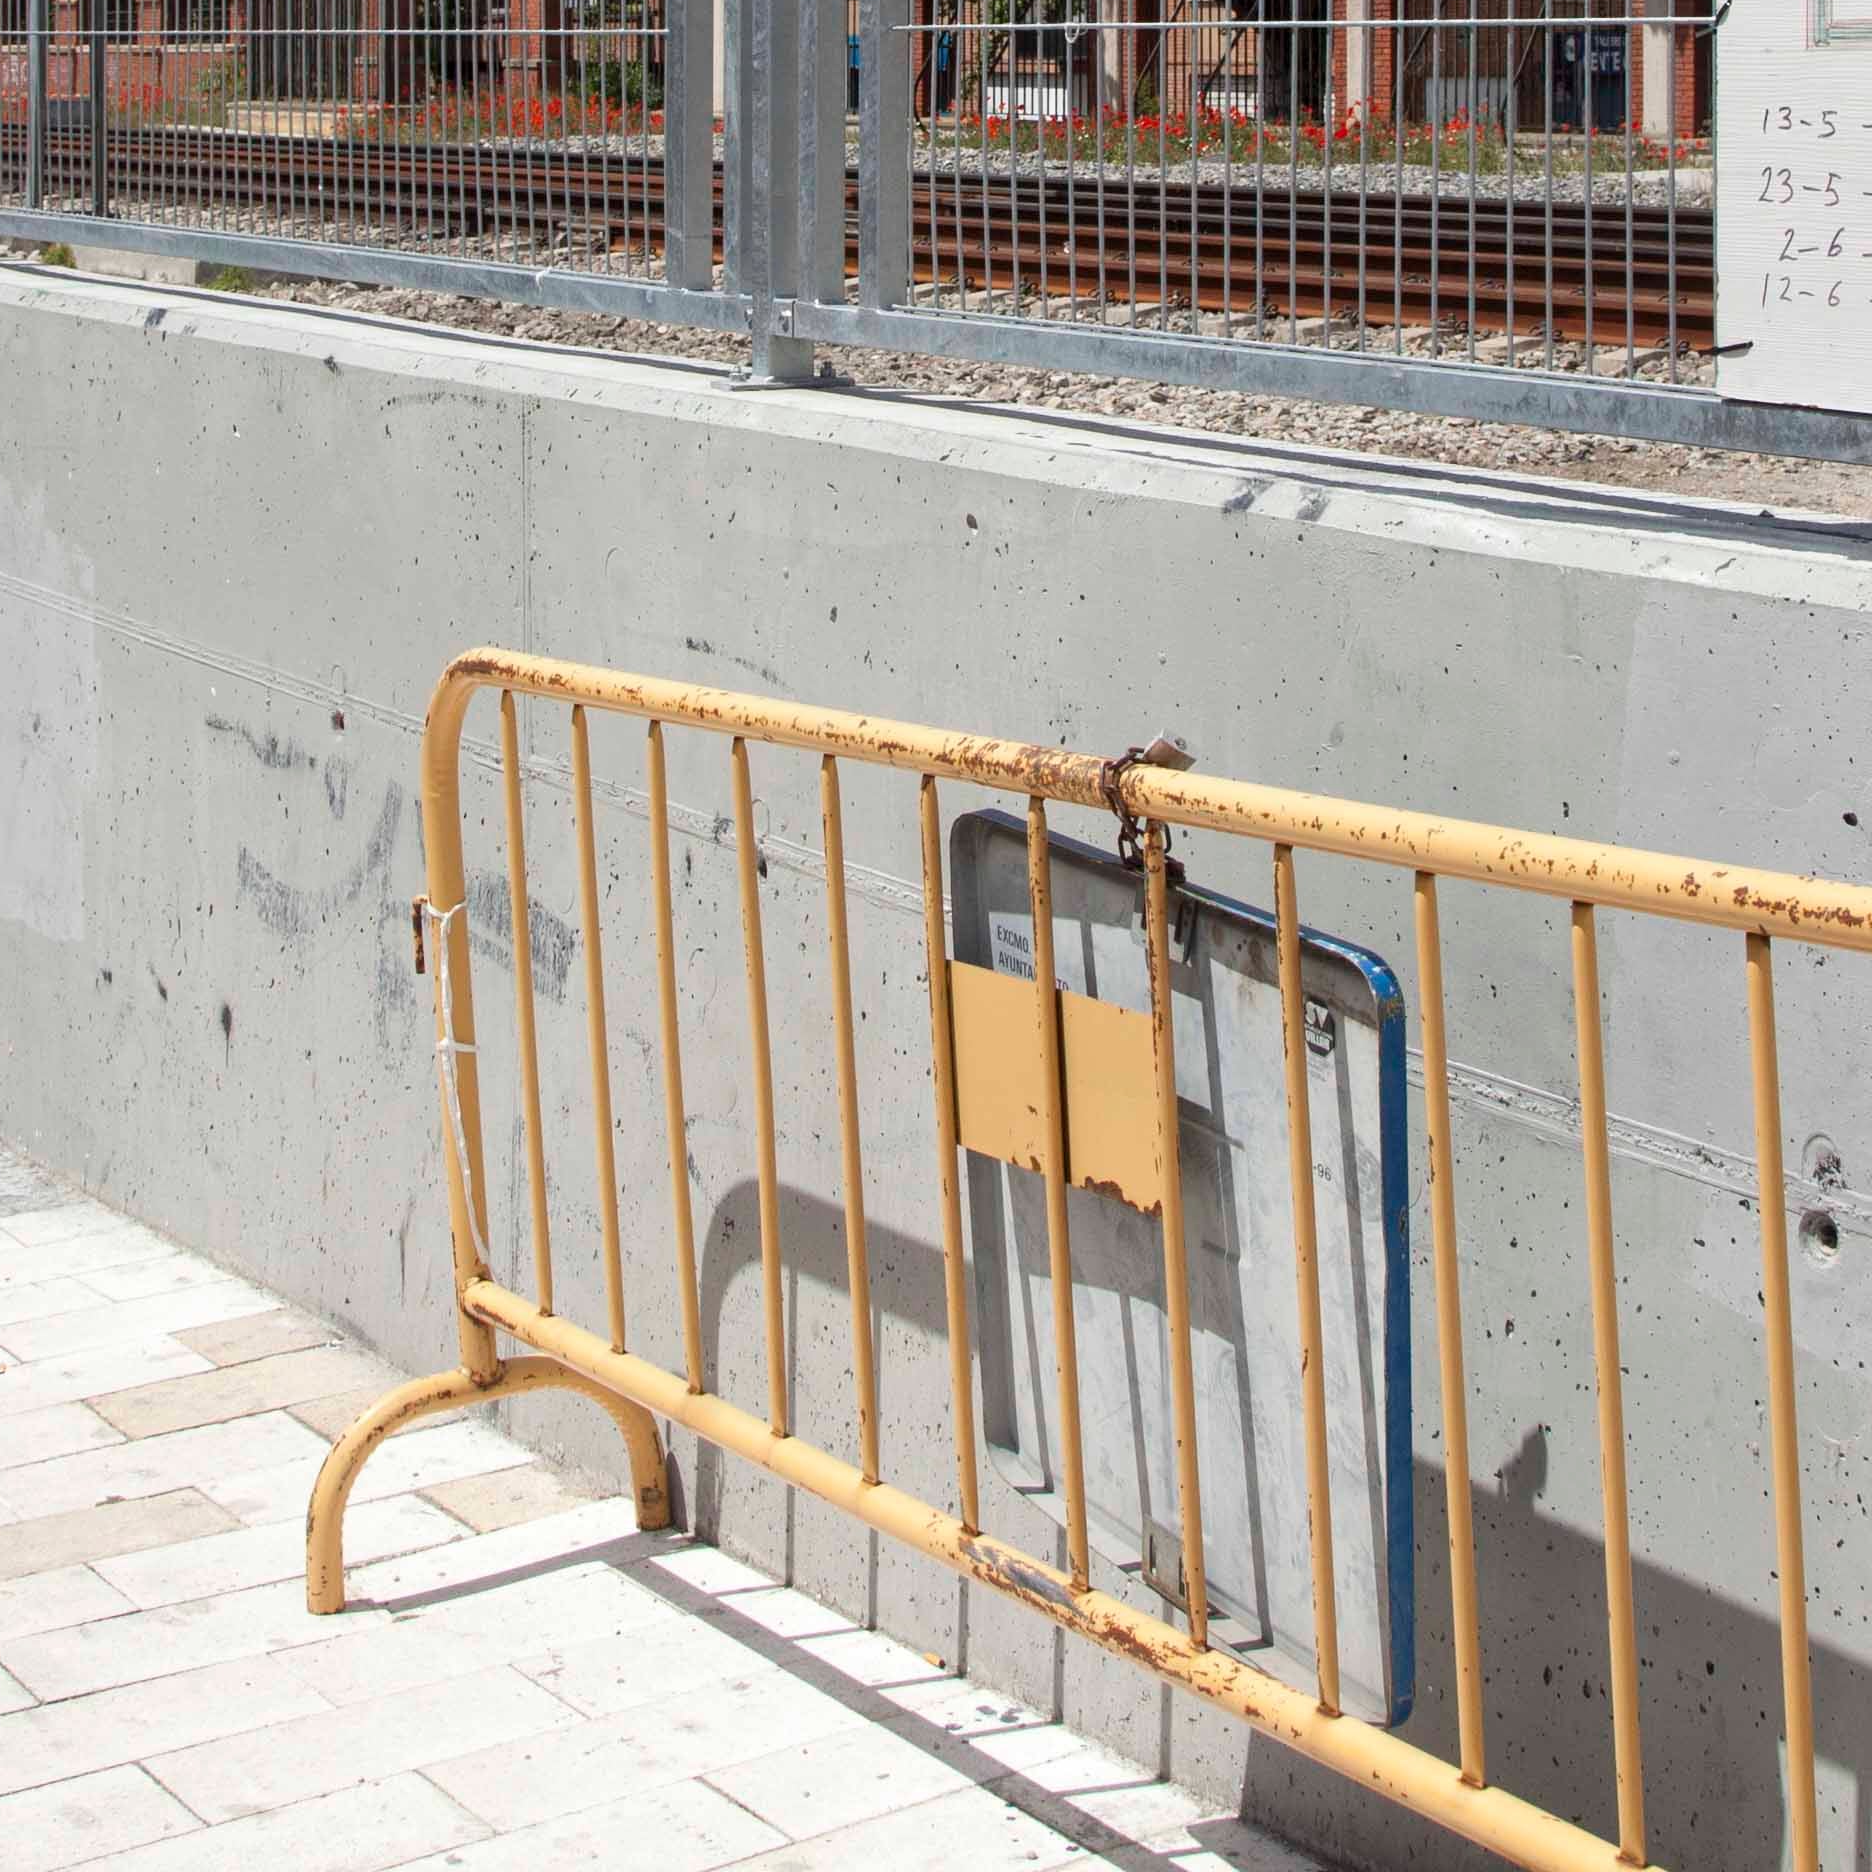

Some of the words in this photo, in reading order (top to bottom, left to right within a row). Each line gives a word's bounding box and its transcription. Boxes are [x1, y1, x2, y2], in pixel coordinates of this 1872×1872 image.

[1763, 107, 1837, 138] 13-5
[1758, 166, 1842, 206] 23-5
[1779, 227, 1844, 261] 2-6
[1762, 273, 1842, 308] 12-6
[998, 951, 1069, 991] AYUNTATO
